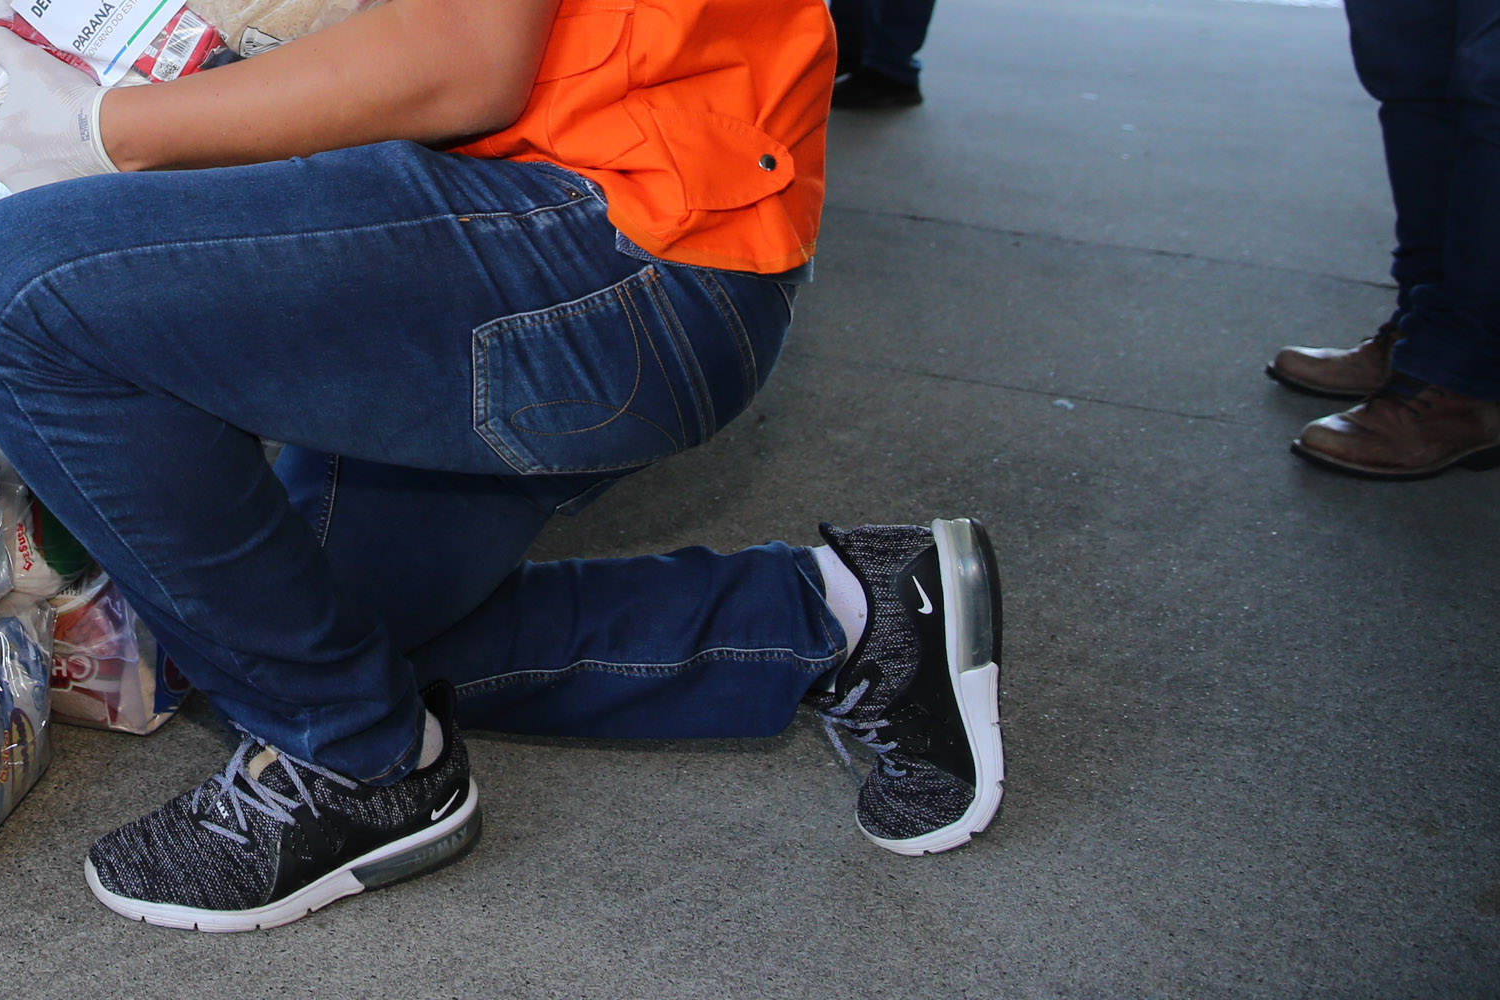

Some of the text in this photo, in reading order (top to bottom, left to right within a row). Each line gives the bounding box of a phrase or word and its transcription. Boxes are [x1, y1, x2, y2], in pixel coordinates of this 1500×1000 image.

[72, 0, 116, 52] PARANÁ
[113, 14, 124, 27] DO
[215, 801, 231, 819] MAX
[437, 826, 470, 855] MAX
